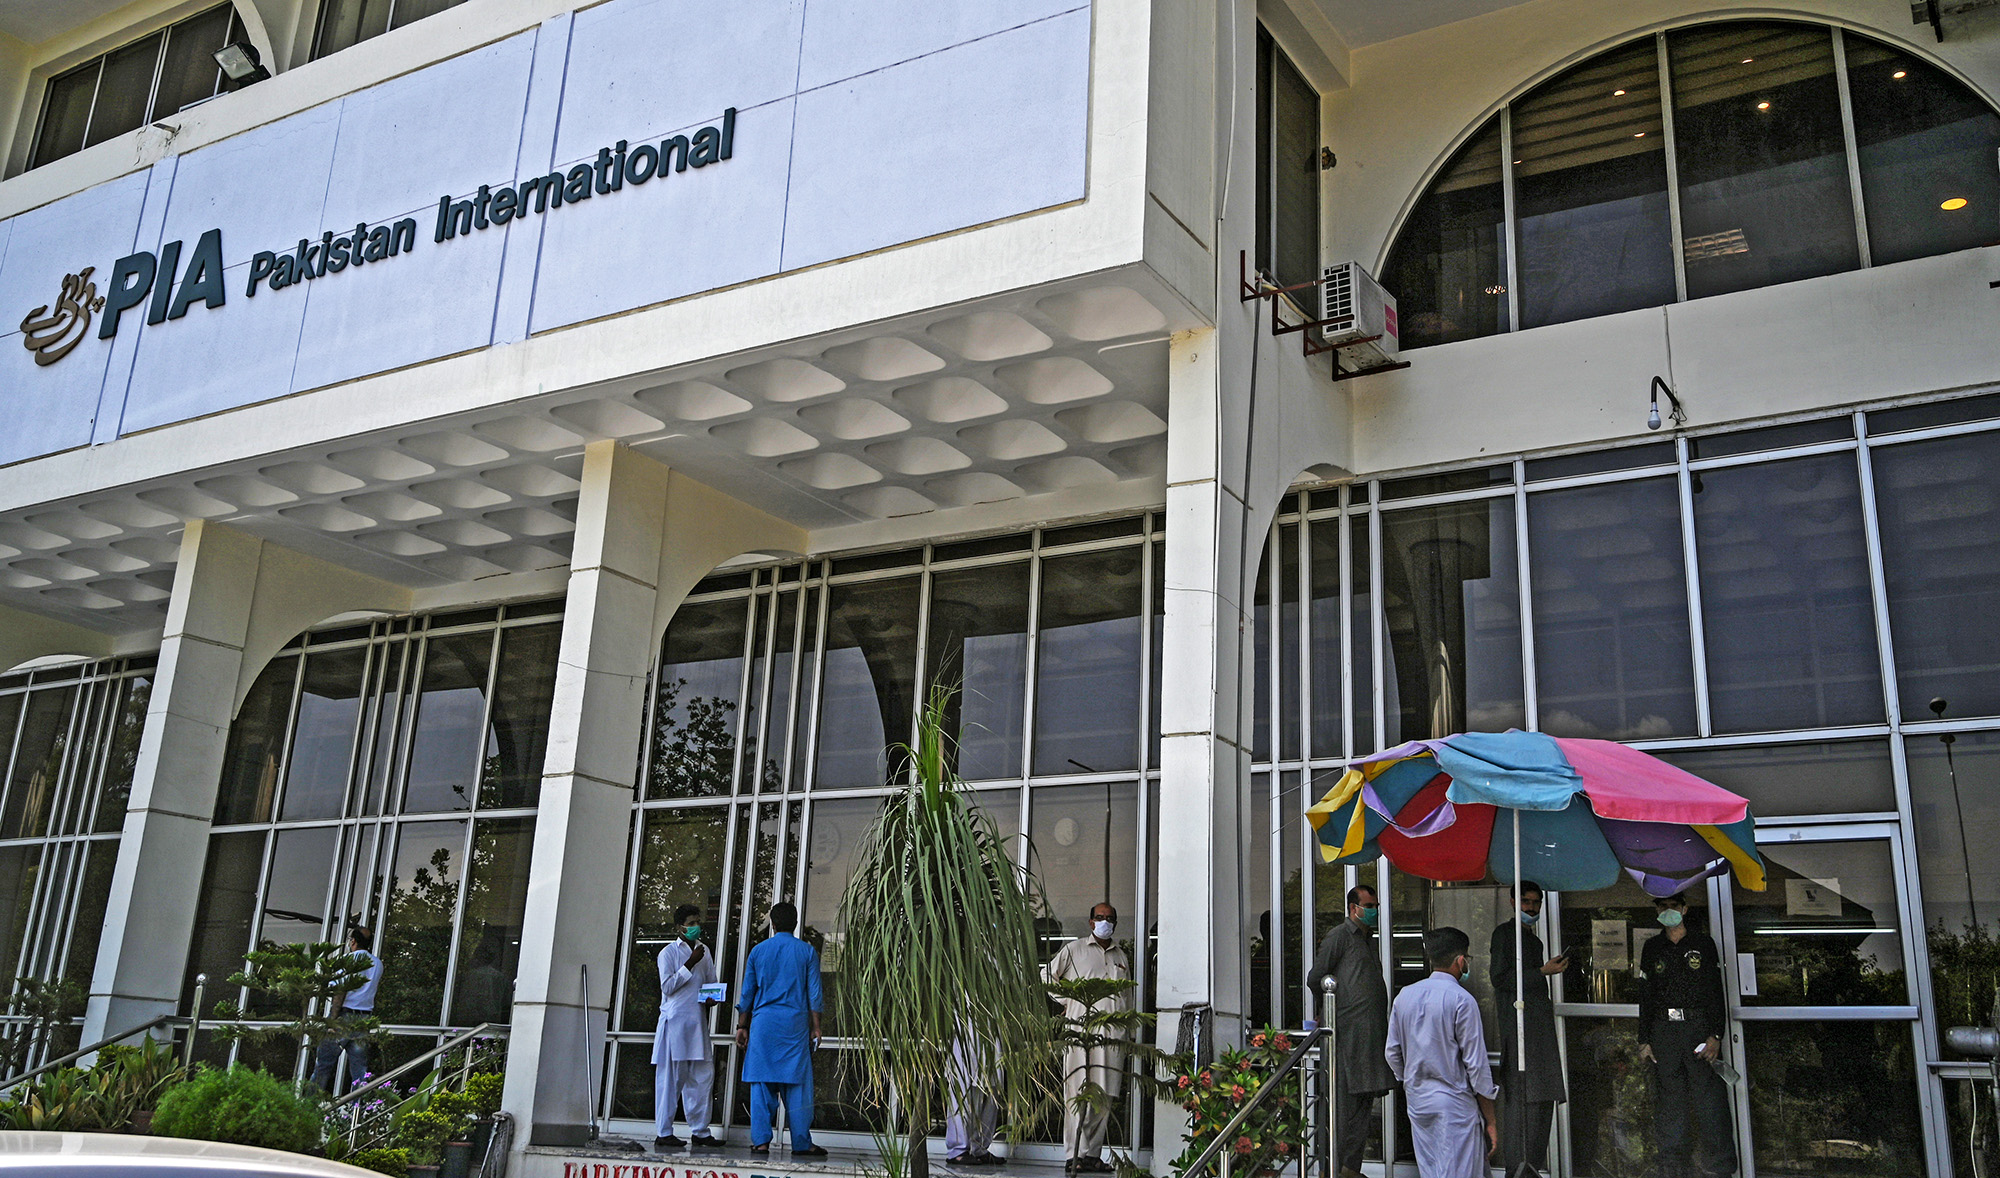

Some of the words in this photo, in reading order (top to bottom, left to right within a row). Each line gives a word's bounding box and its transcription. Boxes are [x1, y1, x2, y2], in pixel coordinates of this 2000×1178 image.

[98, 228, 226, 340] PIA
[246, 217, 417, 298] Pakistan
[434, 107, 737, 243] International
